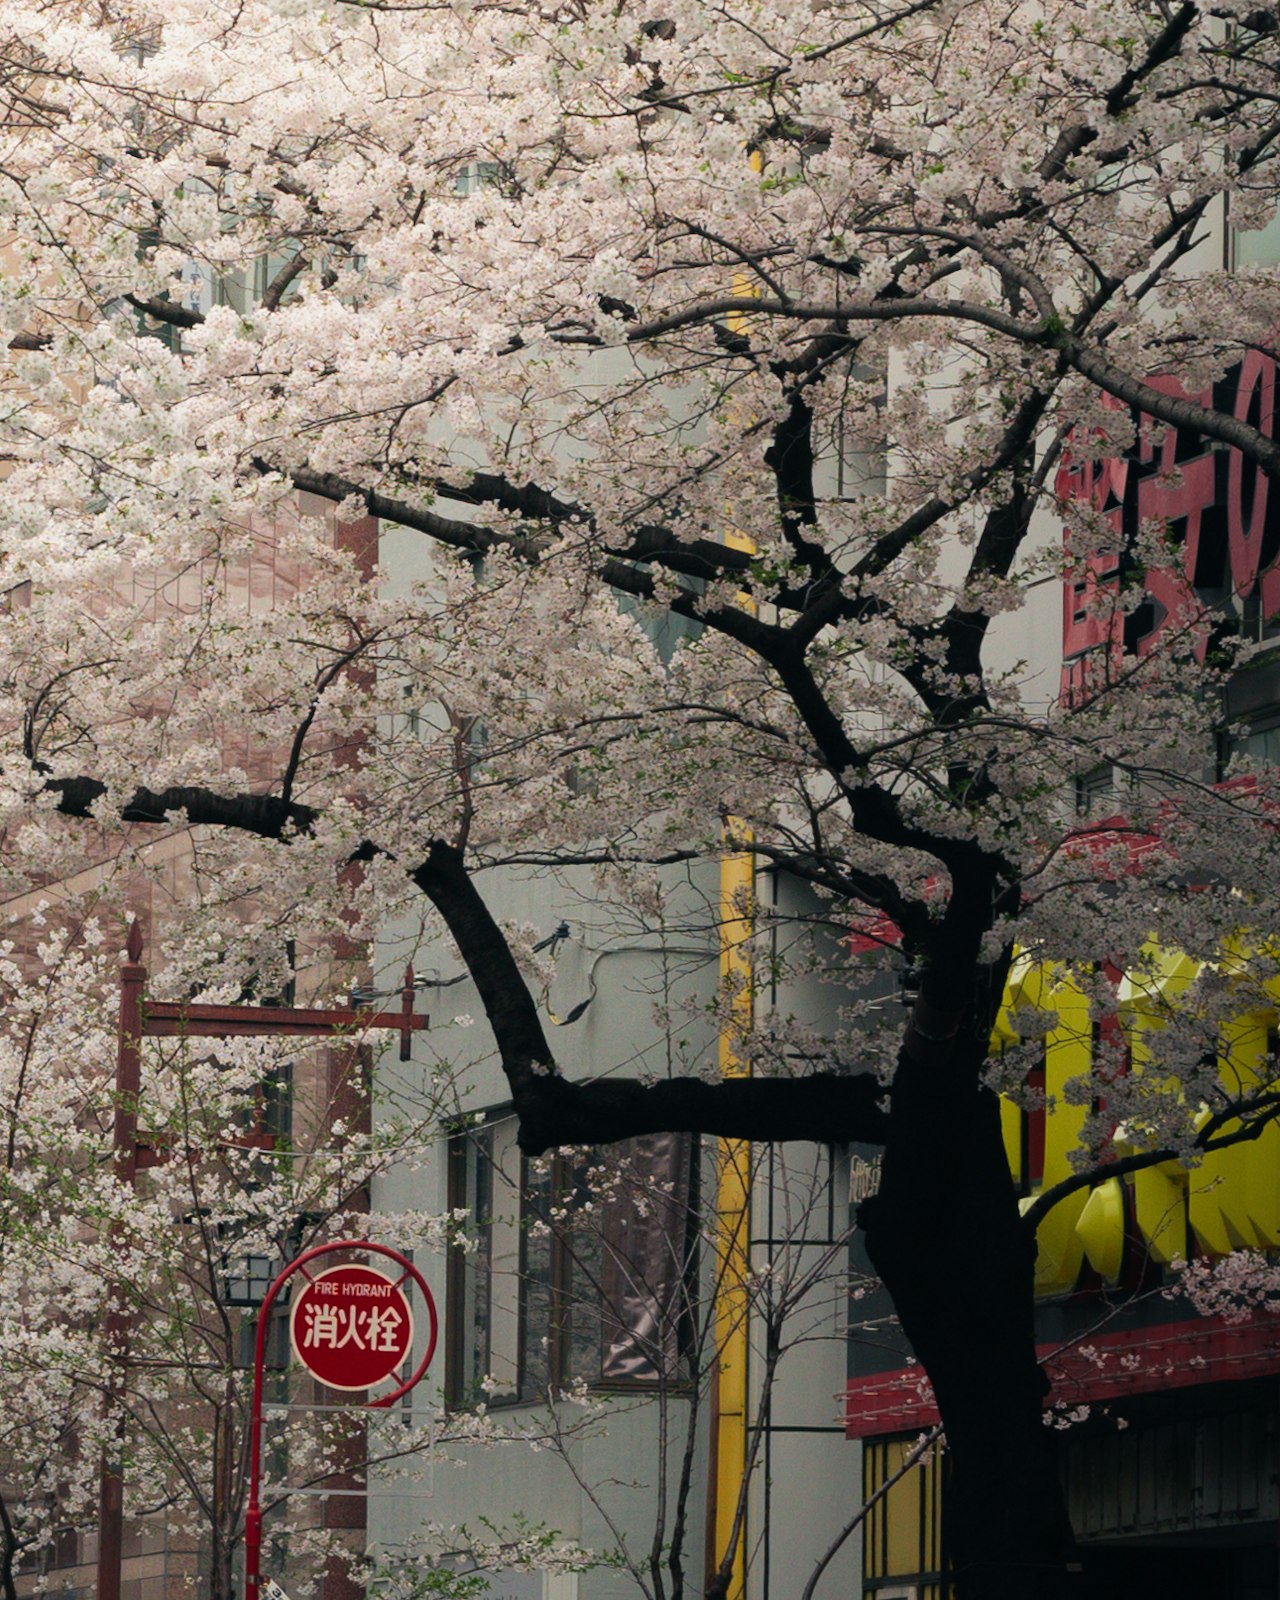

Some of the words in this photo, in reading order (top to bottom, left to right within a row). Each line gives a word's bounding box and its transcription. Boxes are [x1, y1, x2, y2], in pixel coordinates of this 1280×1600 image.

[314, 1281, 339, 1296] FIRE
[342, 1282, 392, 1298] HYDRANT
[303, 1303, 403, 1353] 消火栓
